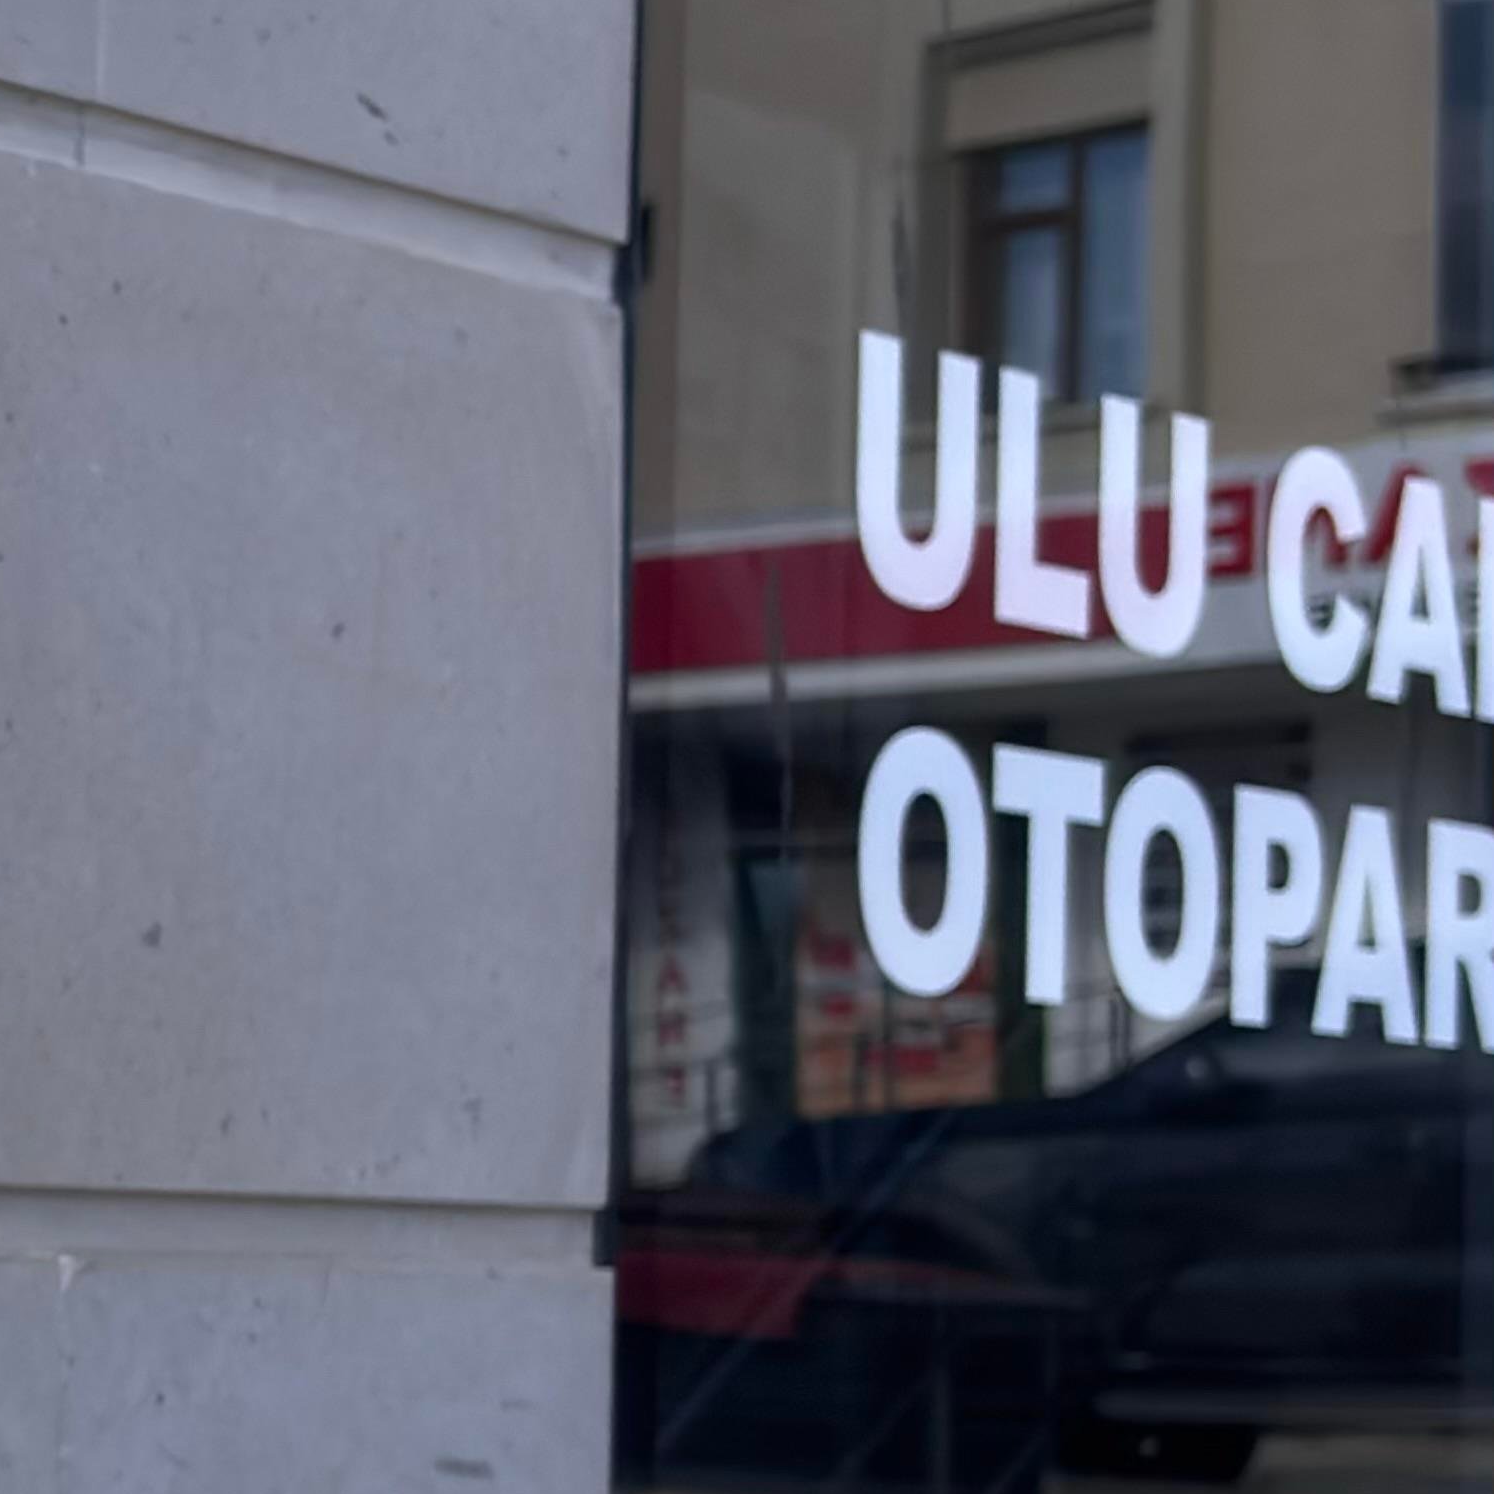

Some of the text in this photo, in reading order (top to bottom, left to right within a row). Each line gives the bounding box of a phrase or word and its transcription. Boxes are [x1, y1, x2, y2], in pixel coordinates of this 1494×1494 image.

[856, 328, 1210, 659] ULU
[1267, 444, 1494, 725] CA
[857, 725, 1494, 1056] OTOPAR
